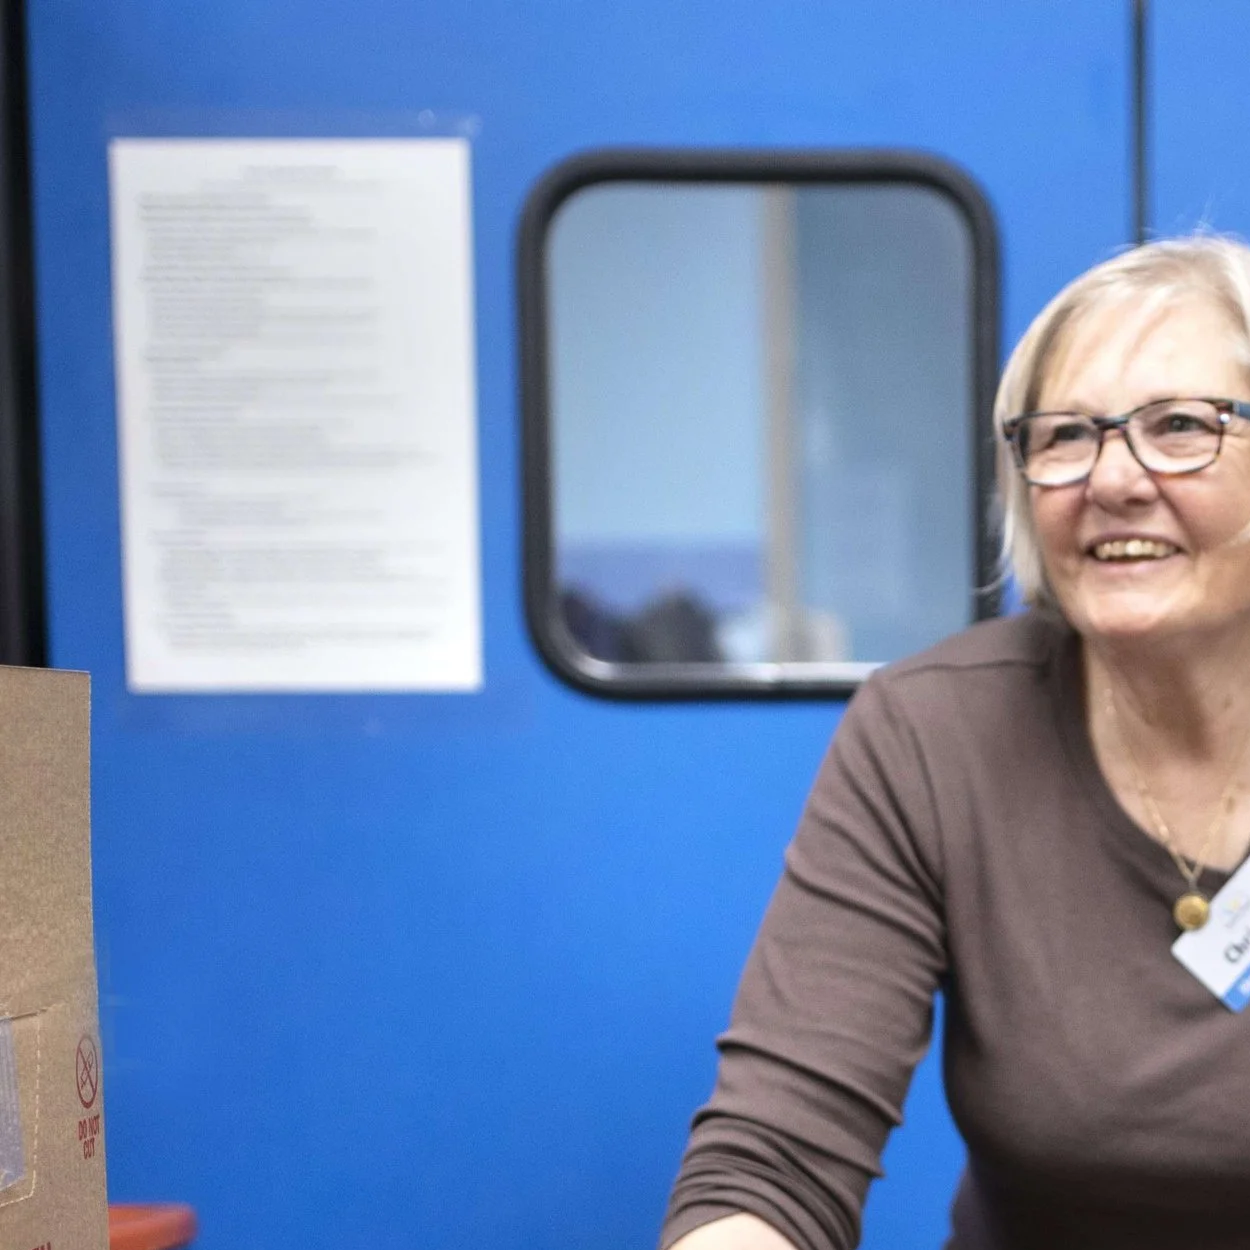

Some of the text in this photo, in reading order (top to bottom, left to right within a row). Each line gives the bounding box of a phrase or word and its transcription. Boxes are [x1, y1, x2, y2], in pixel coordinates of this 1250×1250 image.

[78, 1114, 100, 1141] DO NOT
[83, 1136, 95, 1160] CUT
